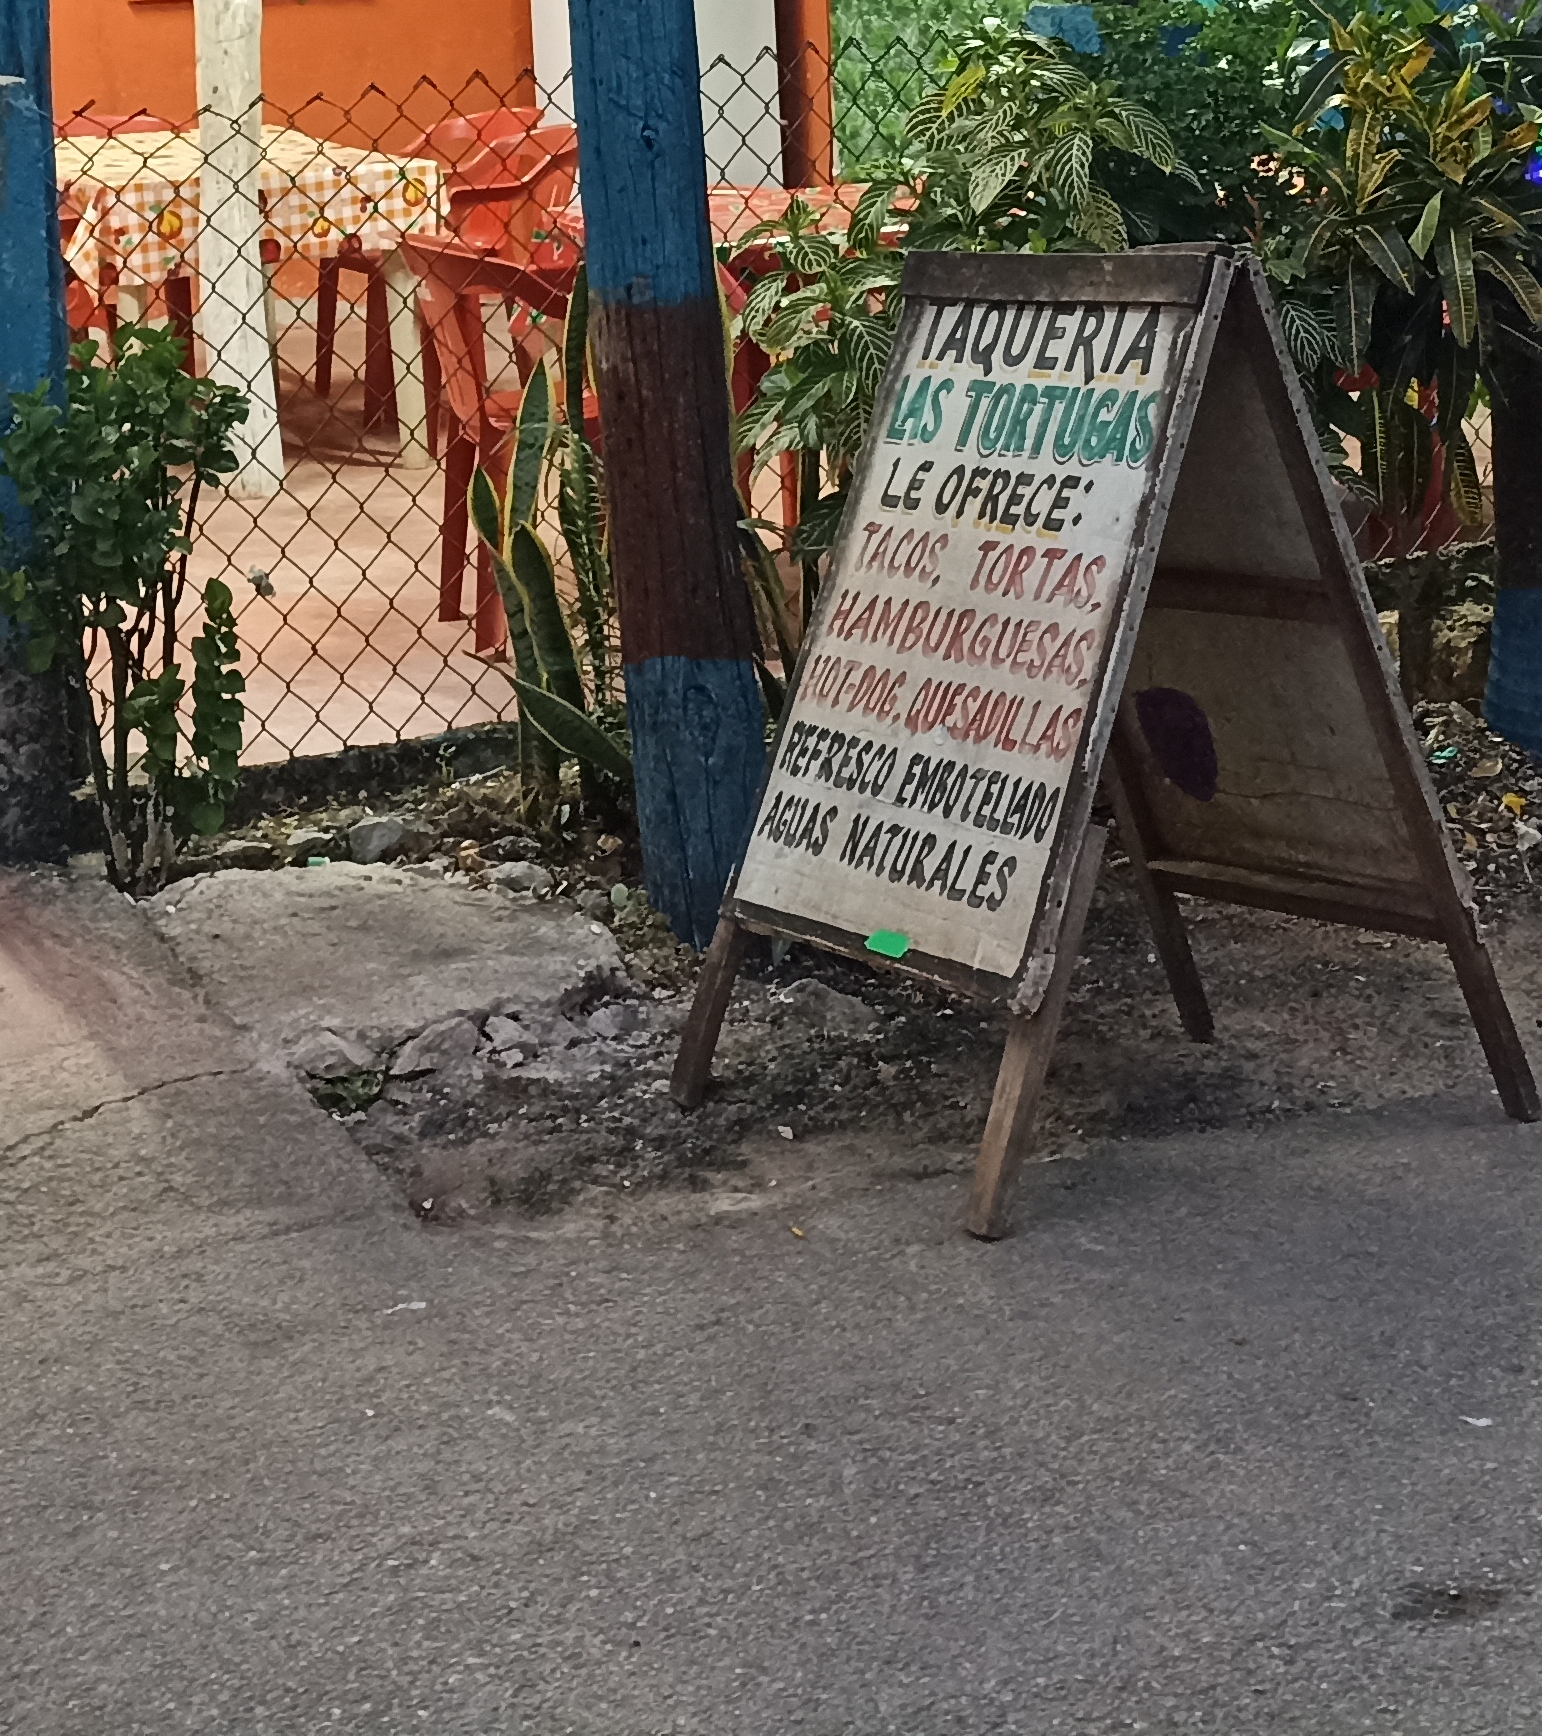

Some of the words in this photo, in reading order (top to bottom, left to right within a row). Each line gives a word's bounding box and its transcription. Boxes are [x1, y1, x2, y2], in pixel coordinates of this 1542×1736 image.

[922, 301, 1160, 385] TAQUERIA
[884, 374, 954, 446] LAS
[955, 379, 1160, 468] TORTUGAS
[880, 457, 934, 511] LE
[934, 463, 1094, 534] OFRECE:
[854, 521, 949, 589] TACOS,
[969, 540, 1106, 613] TORTAS,
[826, 589, 1095, 690] HAMBURGUESAS,
[905, 678, 1082, 762] QUESADILLAS
[778, 720, 898, 798] REFRESCO
[895, 752, 1060, 843] EMBOTELLADO
[757, 791, 838, 856] AGUAS
[839, 813, 1017, 912] NATURALES
